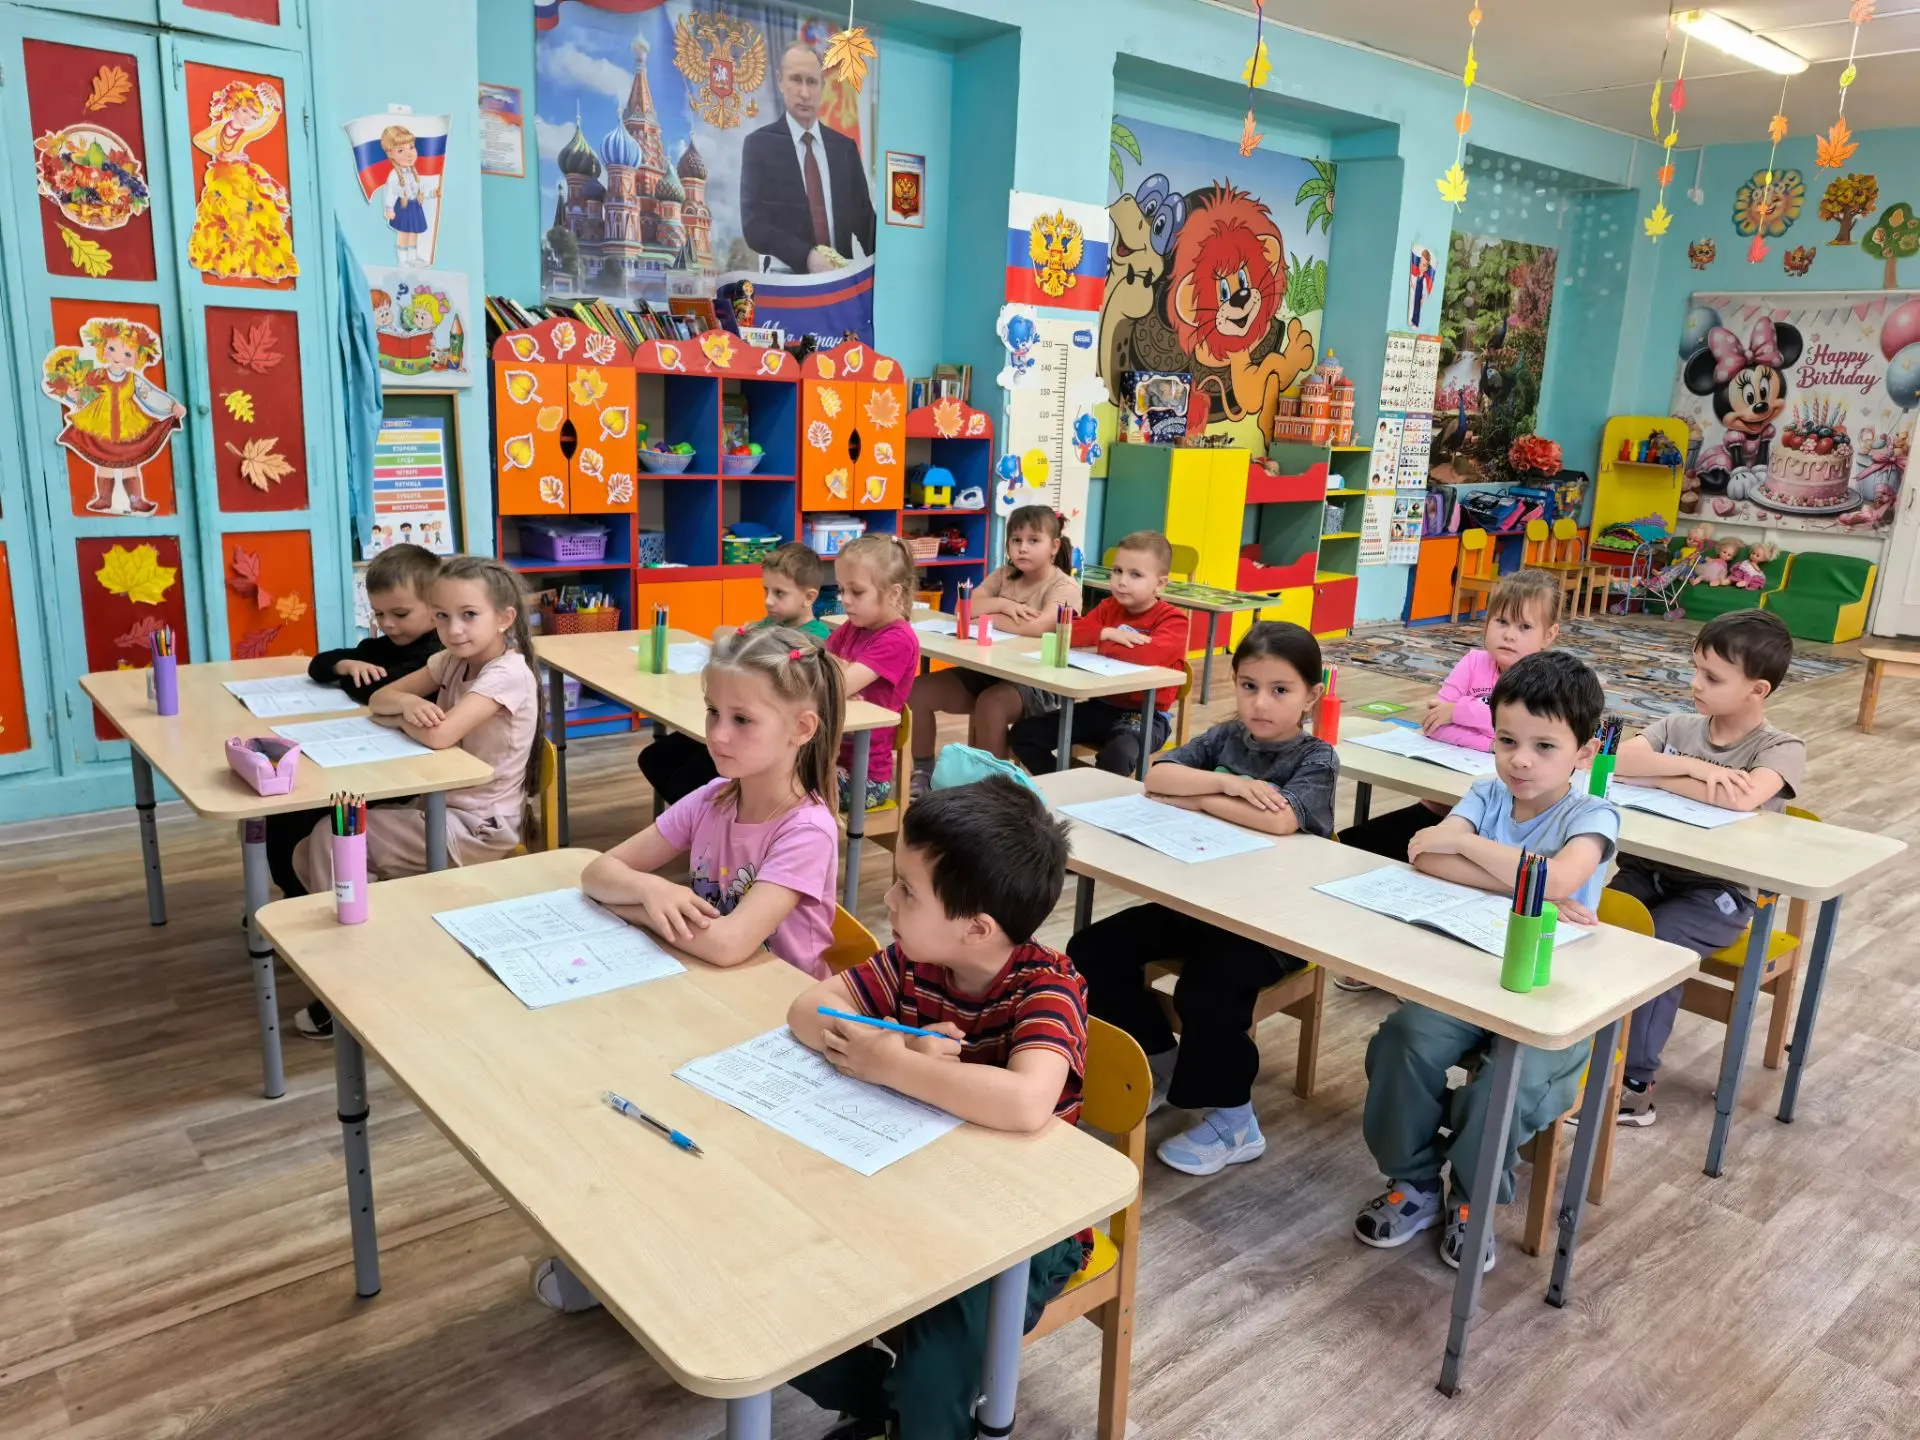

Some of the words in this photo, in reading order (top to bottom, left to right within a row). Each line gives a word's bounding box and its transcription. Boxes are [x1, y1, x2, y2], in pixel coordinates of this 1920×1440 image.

[1805, 344, 1874, 370] Happy
[1796, 366, 1882, 395] Birthday
[1040, 388, 1051, 396] 130
[1037, 457, 1048, 465] 100
